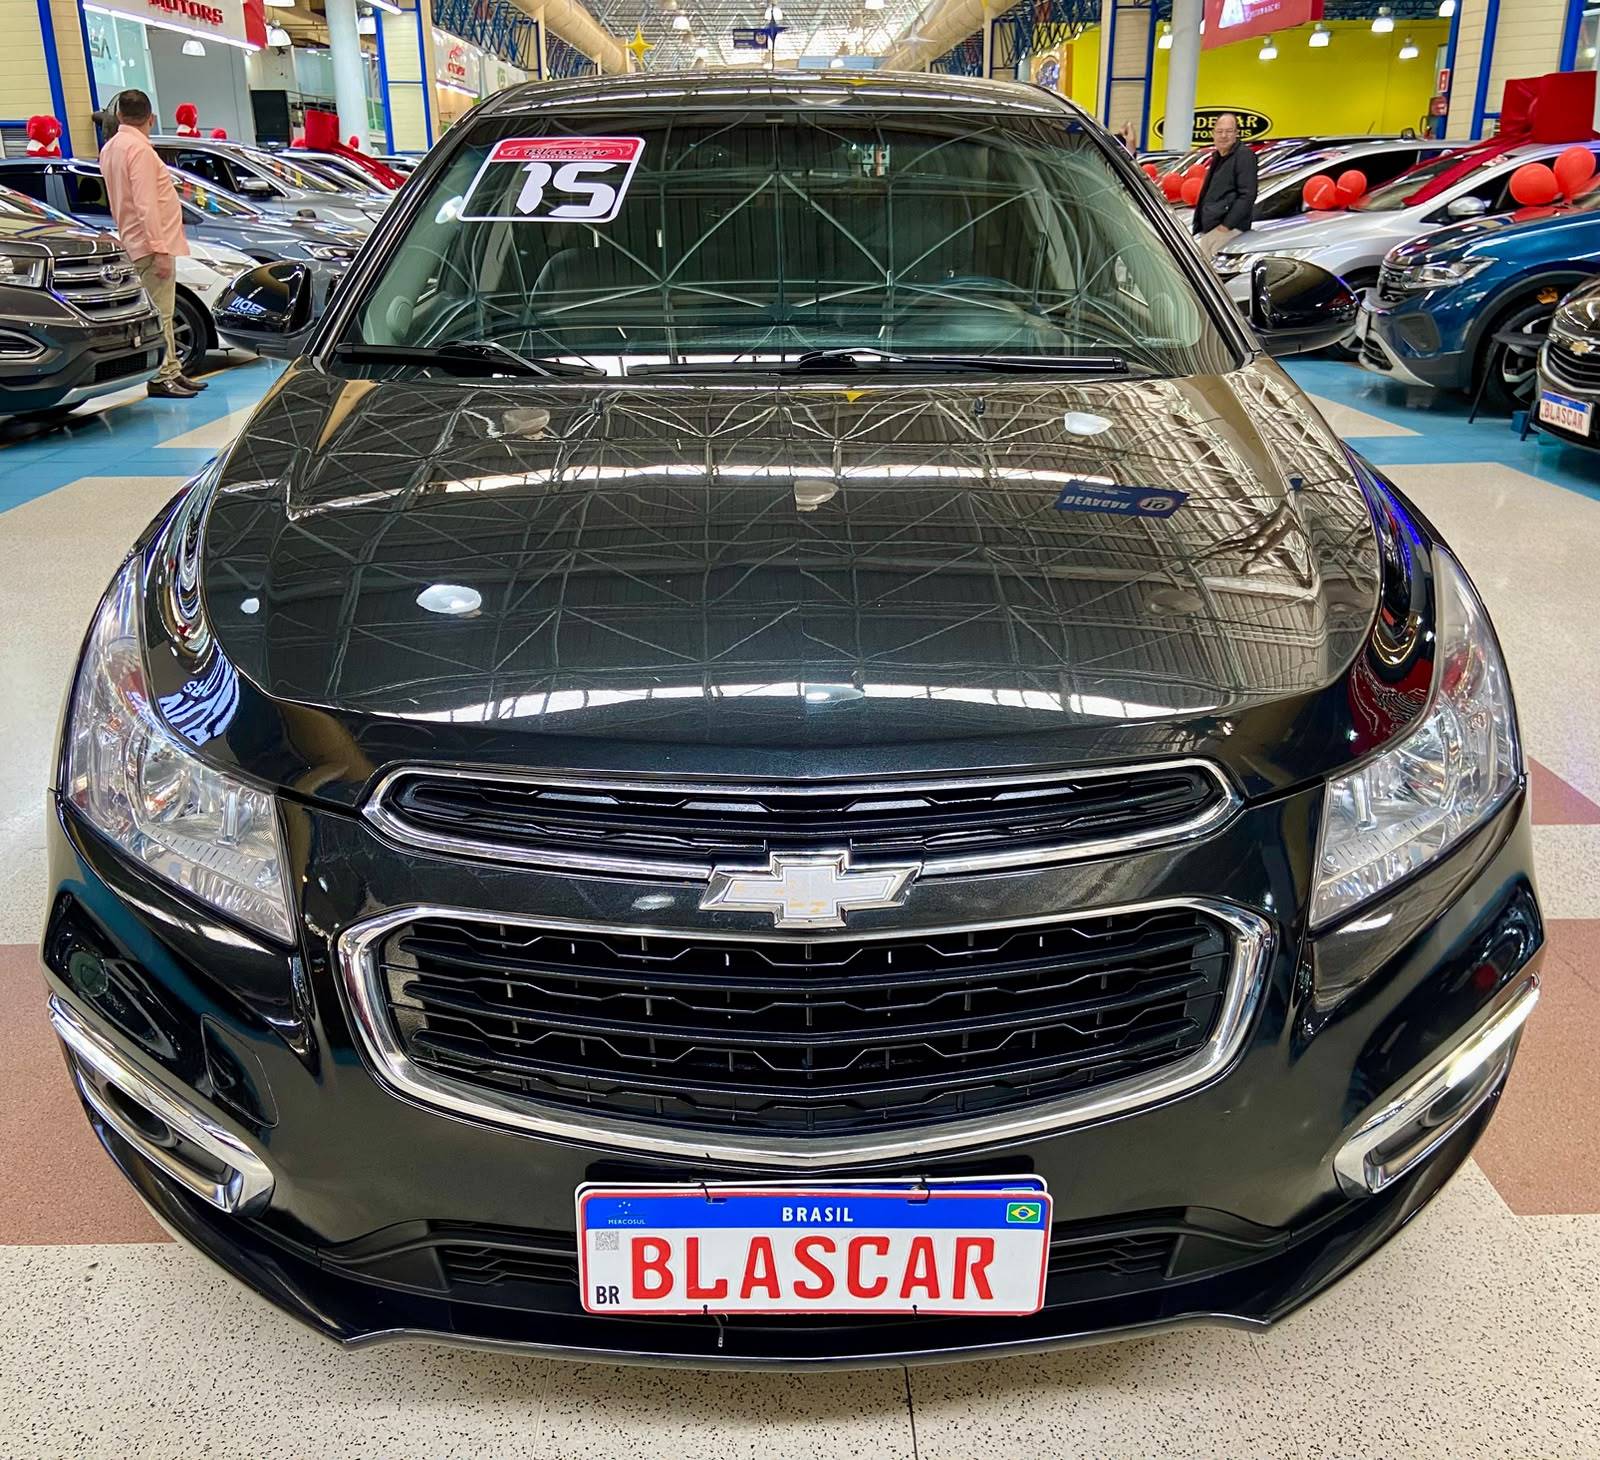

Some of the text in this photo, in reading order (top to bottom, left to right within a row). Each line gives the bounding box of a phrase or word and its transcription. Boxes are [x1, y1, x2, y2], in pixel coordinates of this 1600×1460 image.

[781, 1206, 854, 1223] BRASIL
[631, 1236, 994, 1301] BLASCAR
[595, 1285, 620, 1305] BR
